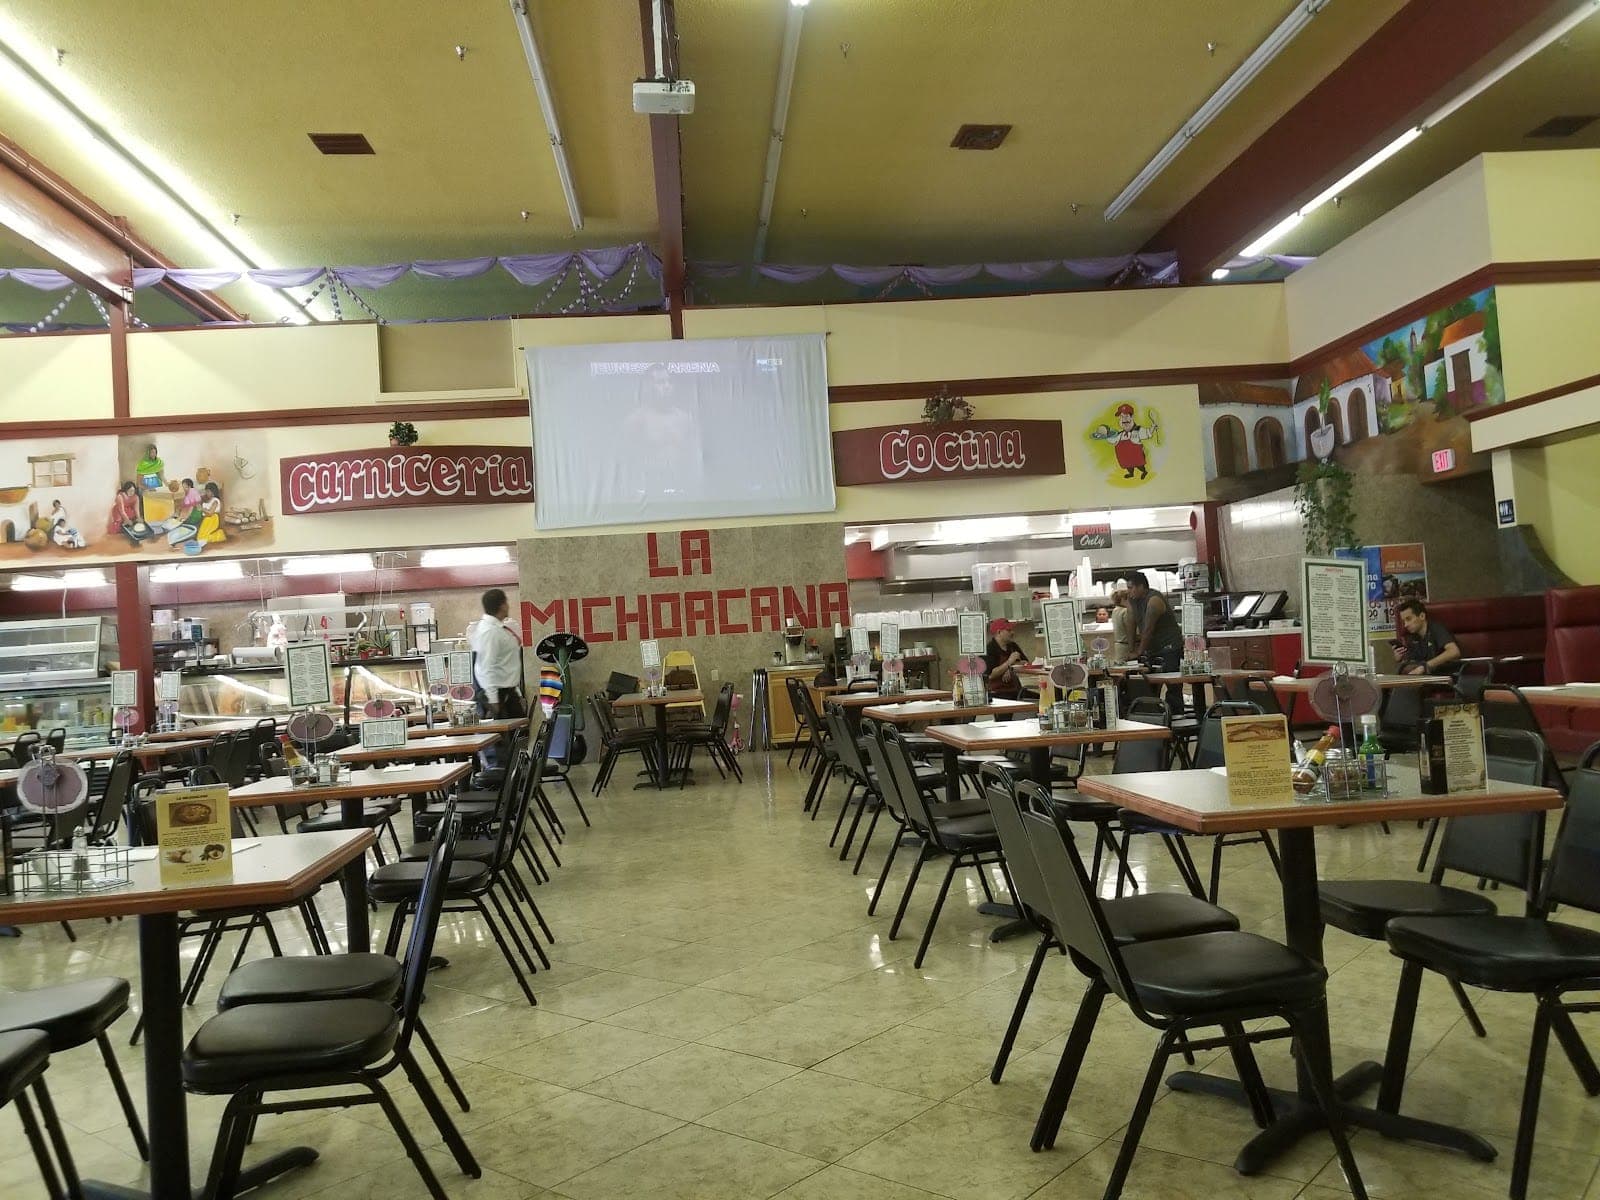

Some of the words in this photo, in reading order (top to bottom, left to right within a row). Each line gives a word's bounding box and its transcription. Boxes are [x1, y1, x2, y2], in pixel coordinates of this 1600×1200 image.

[590, 361, 660, 376] JEUNESS
[667, 361, 720, 374] ARENA
[880, 429, 1025, 479] Cocina
[1434, 450, 1449, 471] EXIT
[646, 529, 712, 578] LA
[1080, 534, 1105, 548] Only
[520, 582, 849, 647] MICHOACANA
